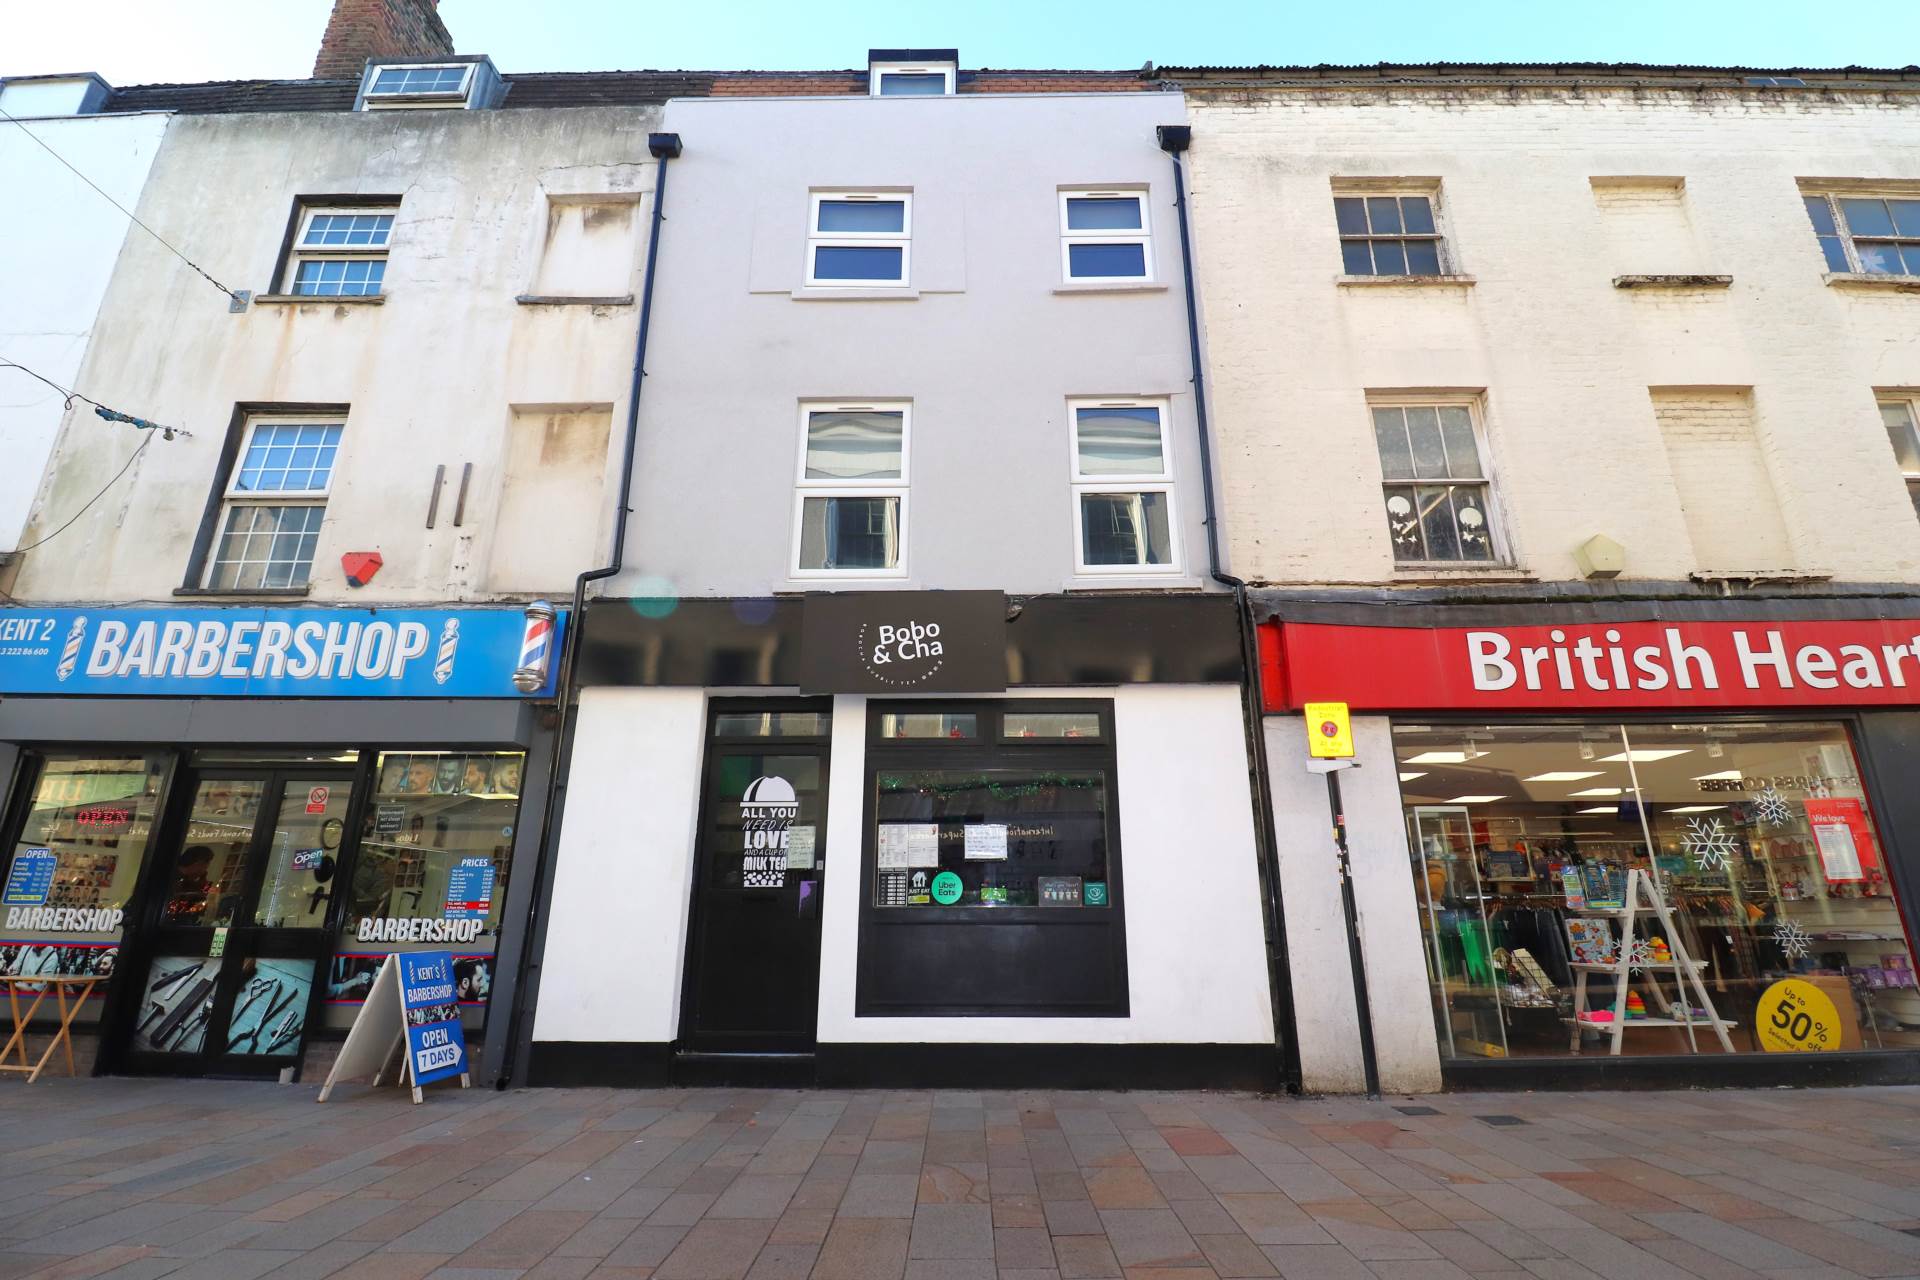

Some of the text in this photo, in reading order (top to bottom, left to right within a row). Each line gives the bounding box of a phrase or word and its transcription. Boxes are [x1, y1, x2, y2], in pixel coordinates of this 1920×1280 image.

[40, 619, 56, 640] 2
[879, 620, 940, 645] Bobo
[86, 620, 429, 679] BARBERSHOP
[873, 638, 943, 664] & Cha
[1466, 628, 1719, 691] British
[77, 810, 129, 824] OPEN
[741, 807, 796, 818] ALL YOU
[742, 819, 794, 831] NEED IS
[744, 830, 790, 849] LOVE
[25, 849, 49, 859] OPEN
[294, 849, 323, 864] Open
[461, 858, 488, 867] PRICES
[743, 856, 787, 871] MILK TEA
[938, 881, 956, 889] Uber
[6, 907, 124, 932] BARBERSHOP
[357, 917, 484, 942] BARBERSHOP
[407, 984, 453, 1003] BARBERSHOP
[1784, 986, 1805, 1006] Up to
[422, 1028, 448, 1048] OPEN
[421, 1049, 455, 1067] 7 DAYS
